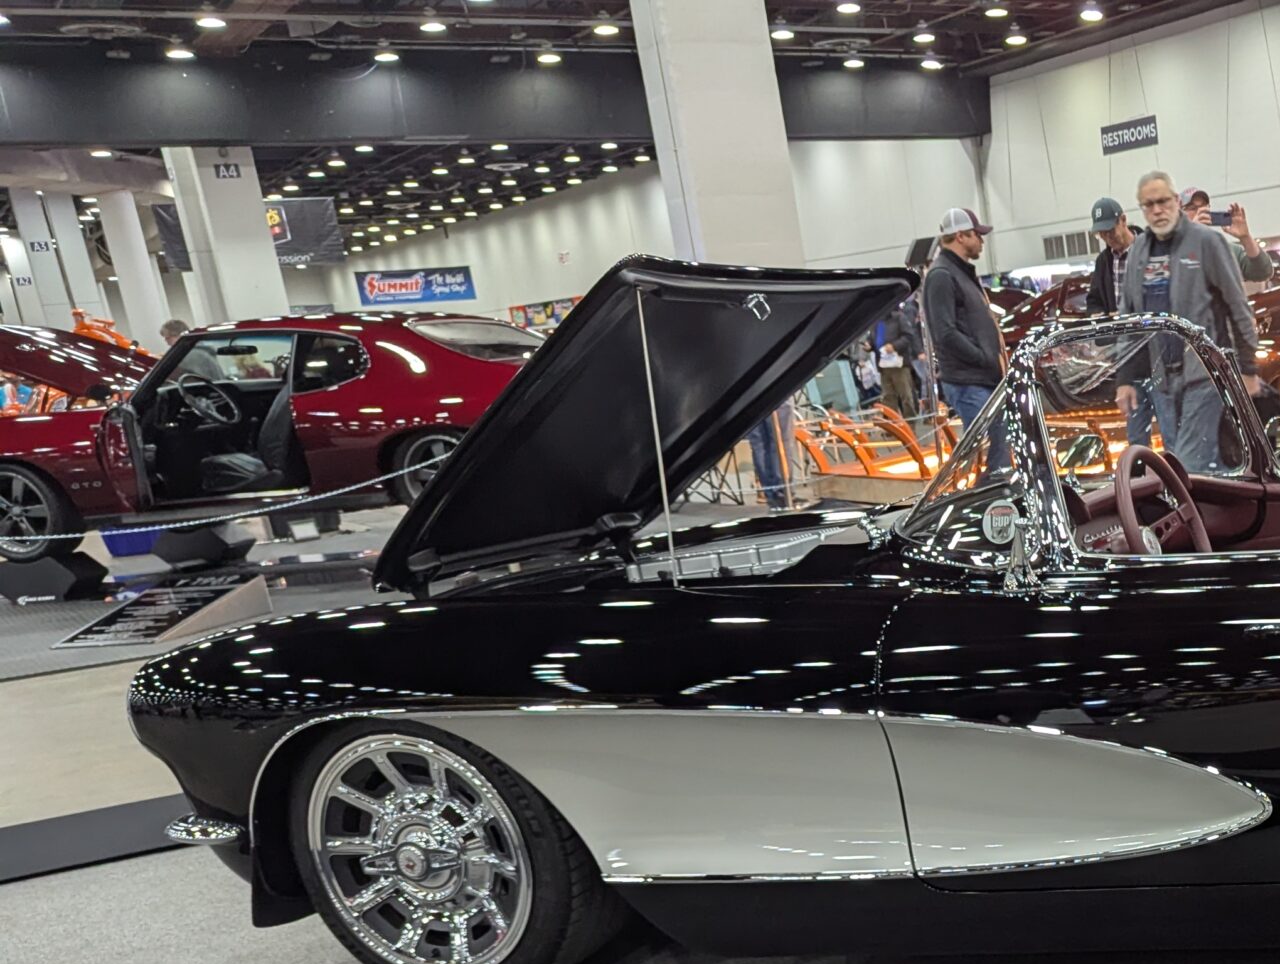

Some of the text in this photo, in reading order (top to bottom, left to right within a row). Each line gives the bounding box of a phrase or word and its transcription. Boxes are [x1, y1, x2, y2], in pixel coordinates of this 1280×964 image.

[1102, 123, 1157, 148] RESTROOMS
[219, 164, 238, 178] A4
[367, 276, 420, 298] SUMMIT
